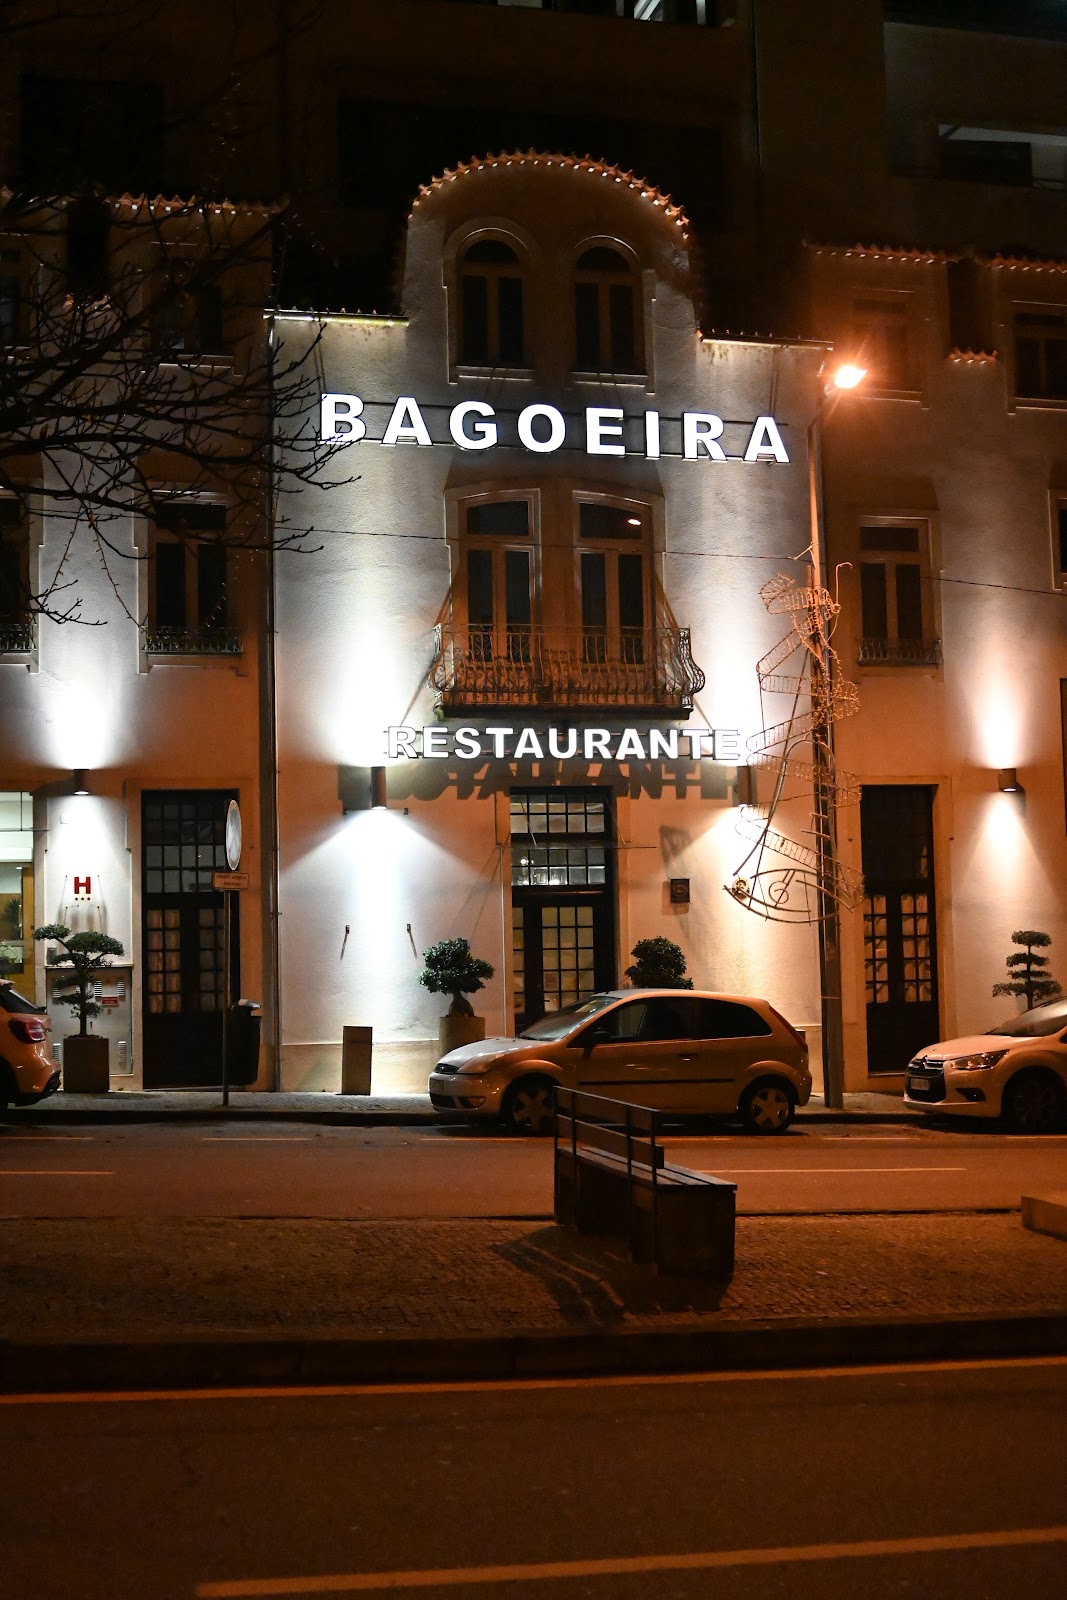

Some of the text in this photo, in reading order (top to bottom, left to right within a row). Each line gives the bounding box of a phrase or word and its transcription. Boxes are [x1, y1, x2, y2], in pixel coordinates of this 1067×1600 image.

[320, 393, 790, 463] BAGOEIRA
[388, 726, 740, 760] RESTAURANTE
[74, 876, 91, 894] H
